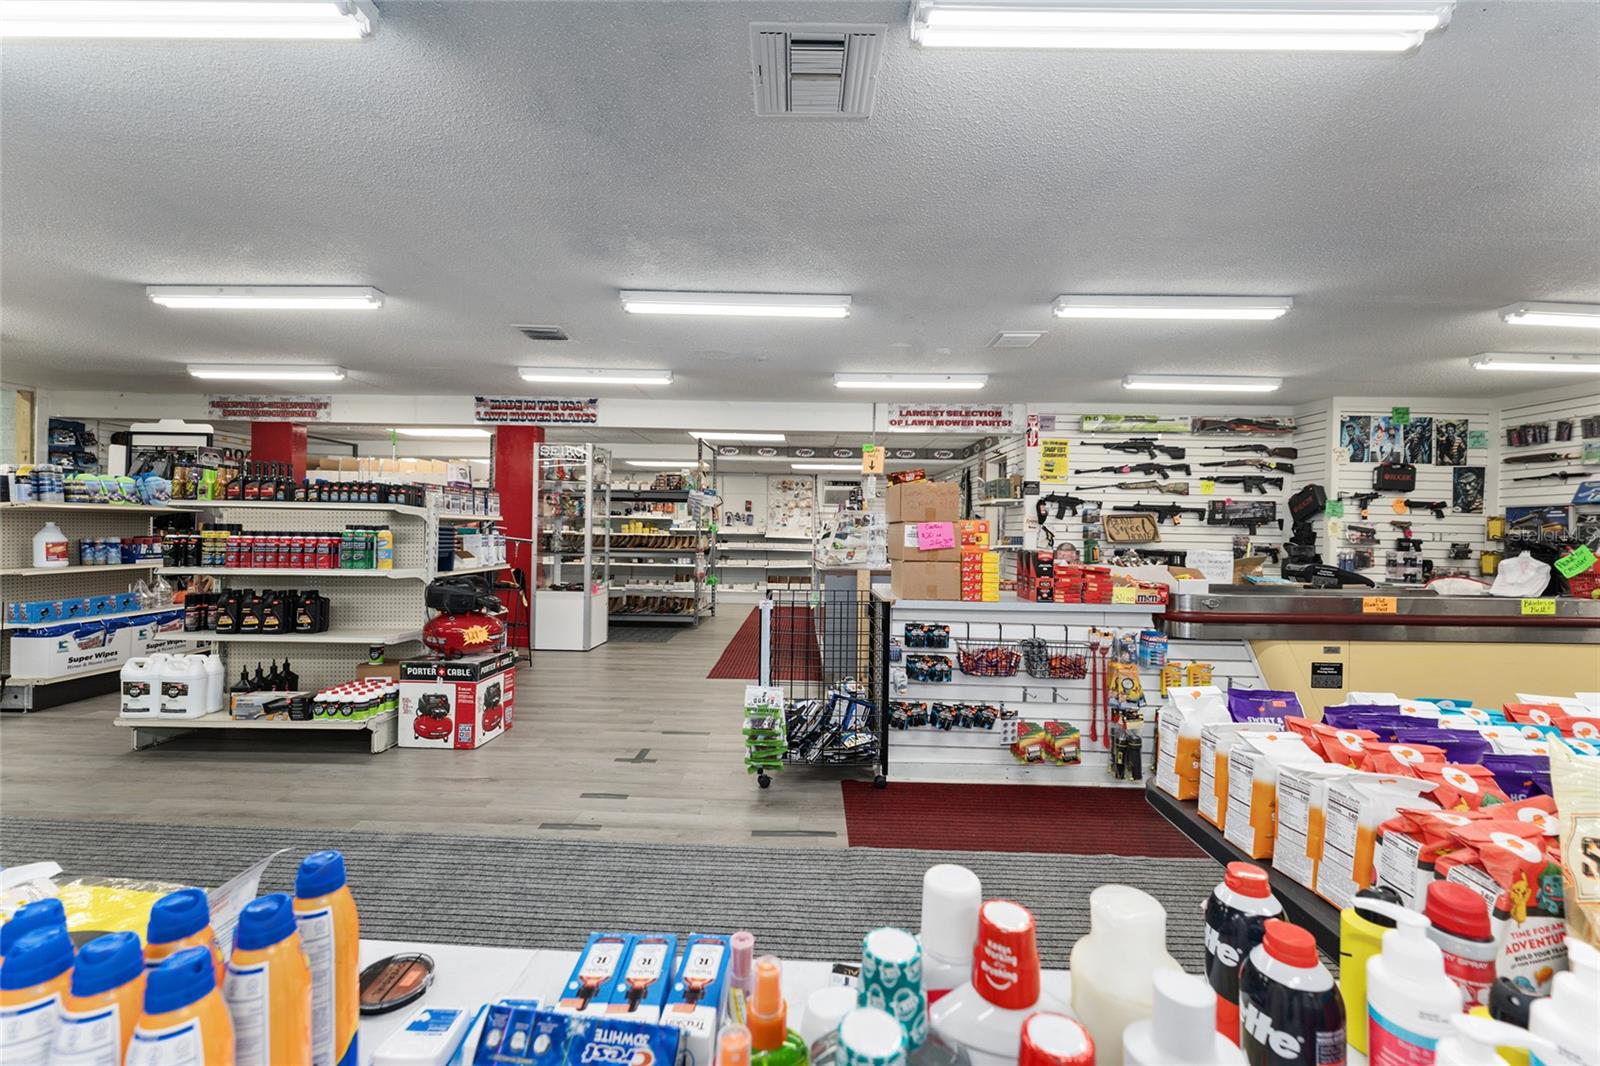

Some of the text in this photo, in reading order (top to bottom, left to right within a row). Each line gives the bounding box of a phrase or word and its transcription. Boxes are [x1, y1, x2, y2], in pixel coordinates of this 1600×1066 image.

[490, 399, 584, 411] MADE IN THE USA
[475, 411, 597, 423] LAWN MOWER BLADES
[899, 410, 1003, 418] LARGEST SELECTION
[145, 641, 167, 650] Super
[68, 650, 118, 664] Super Wipes
[407, 667, 472, 677] PORTER CABLE
[481, 657, 513, 675] PORTER CABLE
[1510, 922, 1565, 940] TIME FOR AN
[1505, 931, 1568, 956] ADVENTUR
[1457, 957, 1489, 969] SPRAY
[1514, 954, 1533, 962] BUILD
[582, 1043, 655, 1066] Crest
